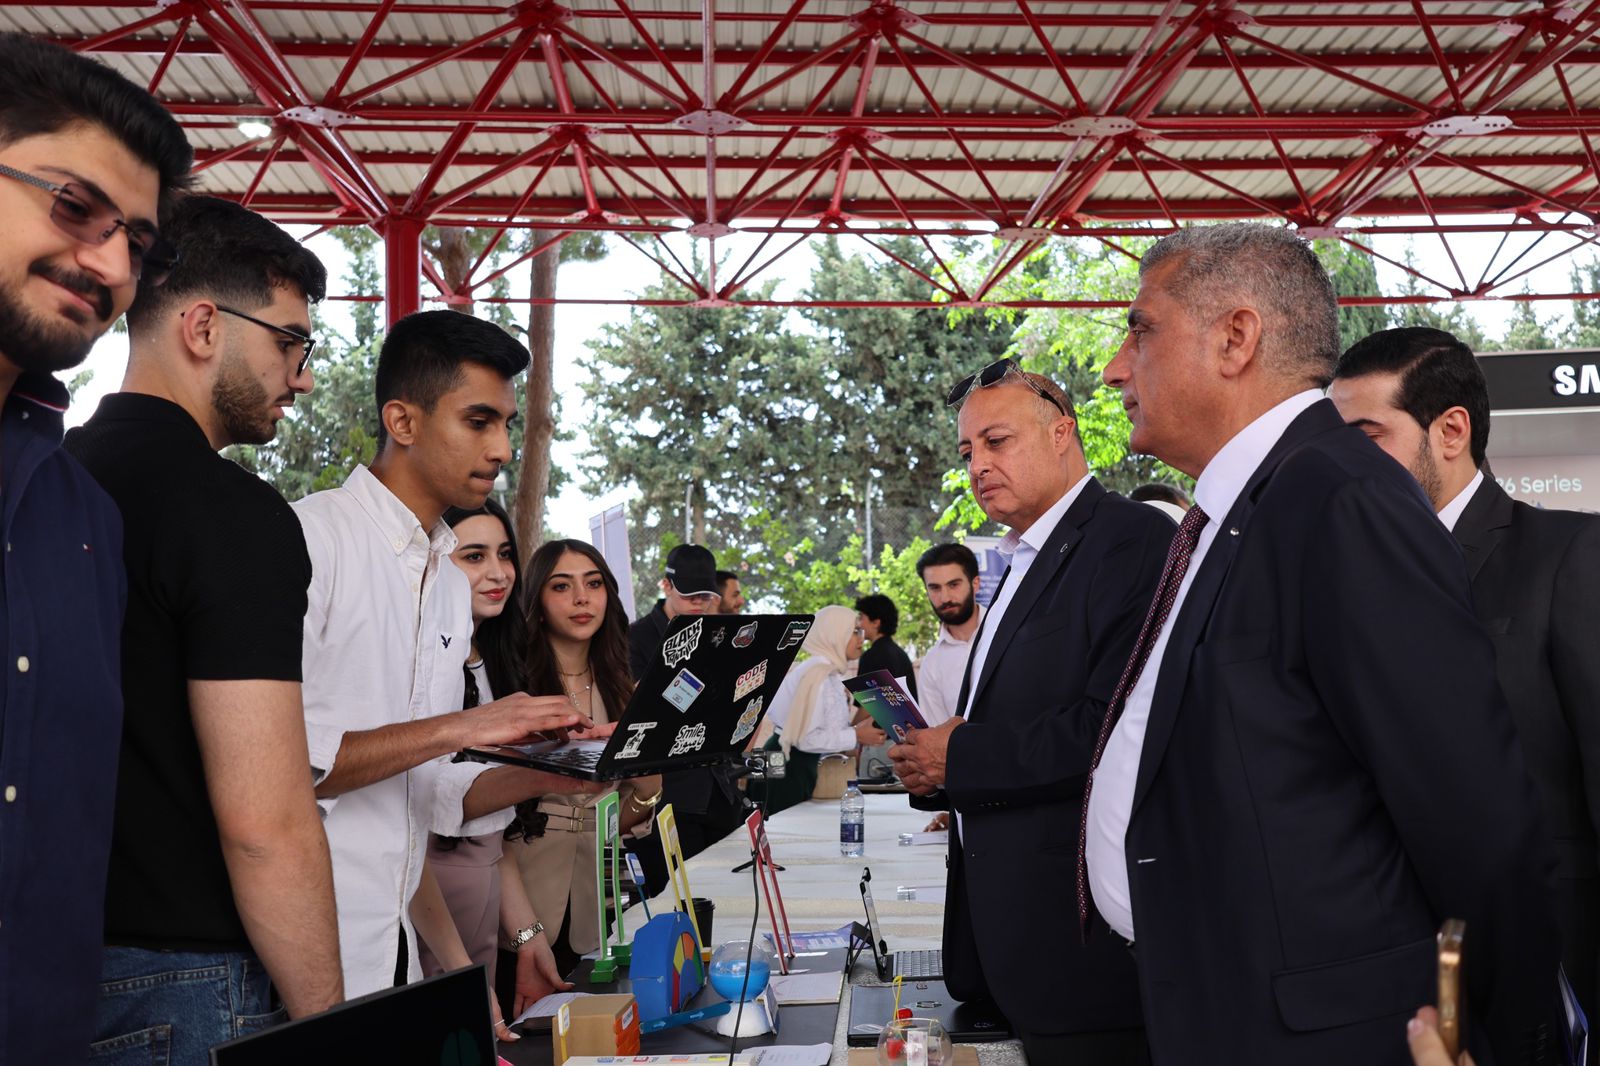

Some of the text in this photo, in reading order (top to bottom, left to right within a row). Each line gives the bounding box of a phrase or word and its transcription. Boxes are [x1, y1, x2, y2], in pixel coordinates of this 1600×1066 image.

[1521, 474, 1582, 494] Series
[665, 621, 702, 651] BLACK
[737, 661, 767, 686] CODE
[676, 723, 706, 741] Smile
